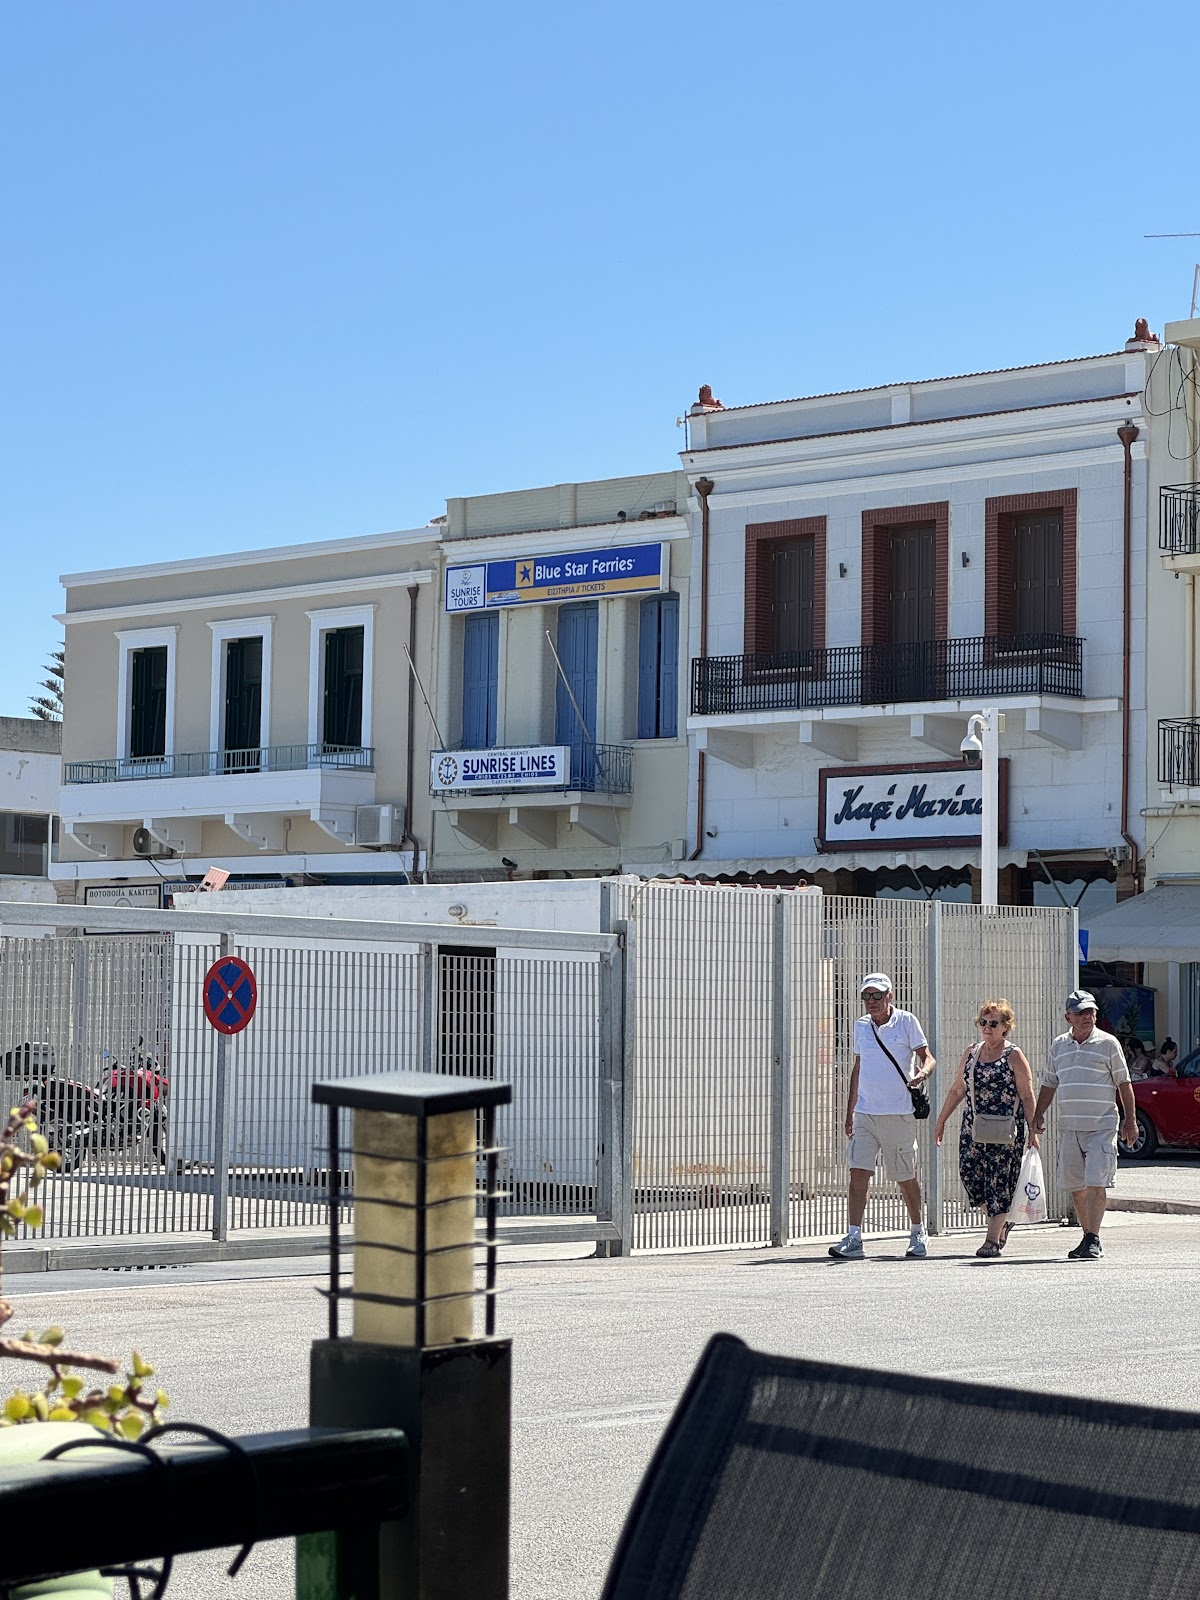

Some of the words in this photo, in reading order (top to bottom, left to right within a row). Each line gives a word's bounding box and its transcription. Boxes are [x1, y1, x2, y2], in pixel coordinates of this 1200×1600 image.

[535, 565, 561, 580] Blue
[565, 562, 589, 577] Star
[592, 556, 633, 574] Ferries
[451, 586, 481, 598] SUNRISE
[547, 586, 575, 596] ΕΙΣΙΤΗΡΙΑ
[582, 582, 605, 593] TICKETS
[454, 596, 478, 607] TOURS
[463, 757, 516, 774] SUNRISE
[520, 755, 555, 771] LINES
[834, 784, 898, 831] Καφέ
[128, 888, 157, 897] ΚΑΚΙΤΣΗ
